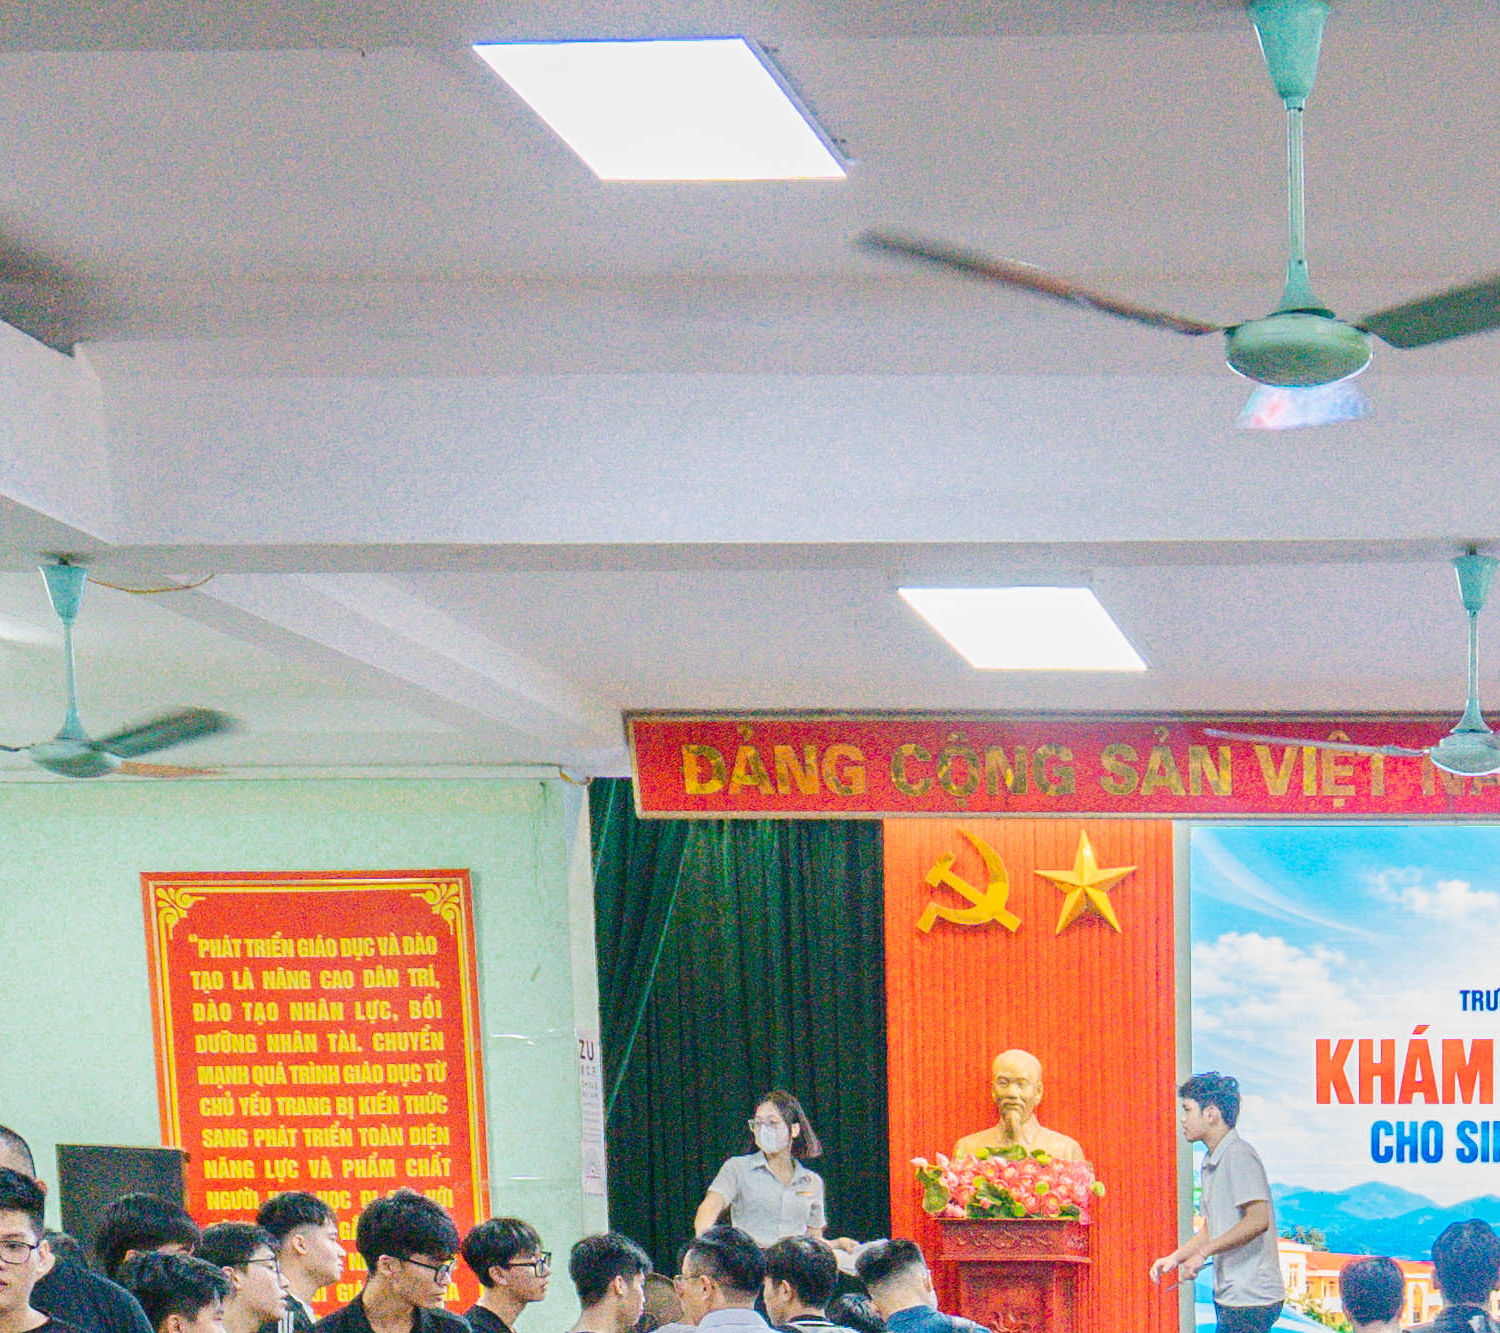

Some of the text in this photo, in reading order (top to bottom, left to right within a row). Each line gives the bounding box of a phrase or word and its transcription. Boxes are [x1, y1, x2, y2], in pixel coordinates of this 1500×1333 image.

[680, 726, 866, 797] ĐẢNG
[890, 732, 1076, 808] CỘNG
[1100, 726, 1235, 798] SẢN
[1253, 731, 1387, 808] VIỆT
[244, 932, 436, 960] TRIỂN GIÁO DỤC ĐÀO
[262, 964, 439, 989] NÂNG CAO DÂN TRÍ,
[289, 995, 441, 1023] NHÂN LỰC, BỒI
[372, 1025, 443, 1051] CHUYỂN
[579, 1039, 594, 1061] ZU
[198, 1061, 339, 1088] MẠNH TRÌNH
[1316, 1026, 1493, 1104] KHÁM
[358, 1091, 447, 1114] KIẾN THỨC
[303, 1121, 449, 1149] TRIỂN TOÀN DIỆN
[1371, 1120, 1443, 1163] CHO
[204, 1152, 450, 1179] NĂNG CHẤT
